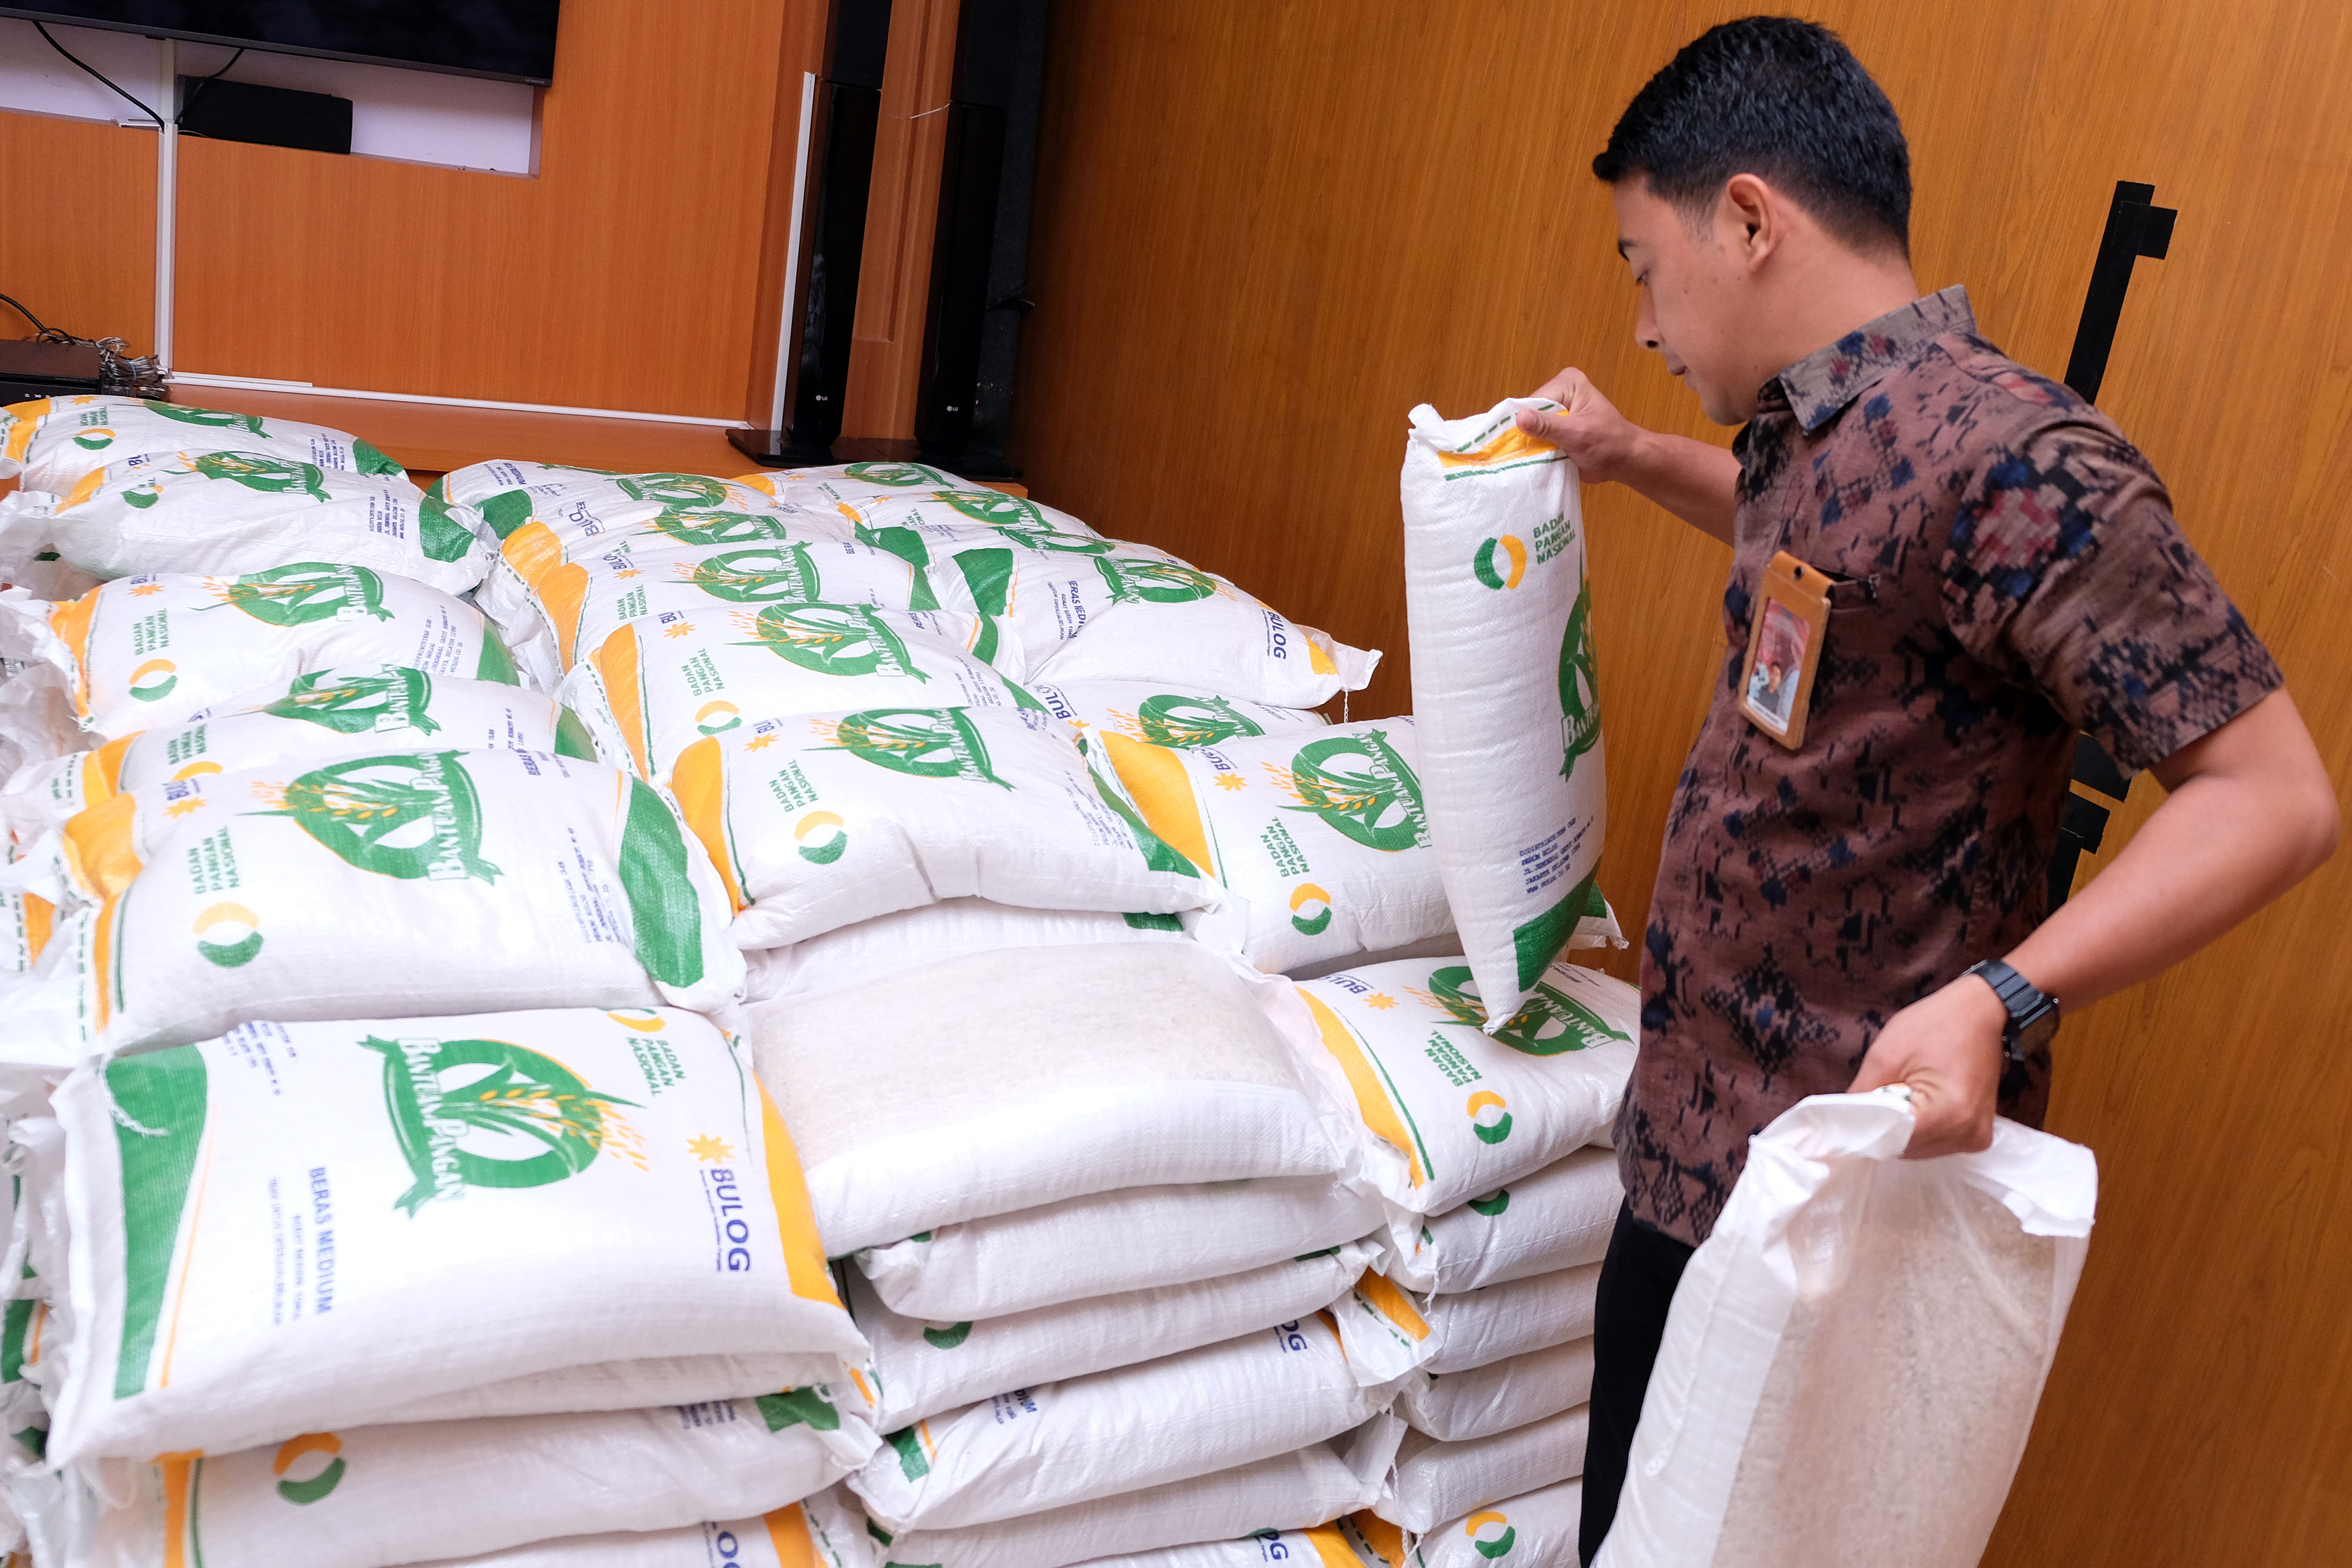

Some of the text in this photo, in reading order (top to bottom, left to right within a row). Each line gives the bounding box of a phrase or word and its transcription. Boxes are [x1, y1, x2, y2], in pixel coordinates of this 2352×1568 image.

[626, 592, 638, 617] PANGAN
[636, 584, 649, 615] NASIONAL
[784, 570, 808, 603] BANTUAN
[157, 608, 169, 648] NASIONAL
[617, 598, 627, 620] BADAN
[132, 622, 143, 655] BADAN
[143, 615, 156, 651] PANGAN
[867, 629, 906, 677] BANTUAN
[1267, 611, 1287, 660] BULOG
[681, 664, 702, 696] BADAN
[689, 657, 714, 693] PANGAN
[697, 647, 725, 690] NASIONAL
[768, 780, 795, 812] BADAN
[777, 769, 807, 808] PANGAN
[787, 759, 819, 802] NASIONAL
[1351, 732, 1432, 849] BANTUAN PANGAN
[216, 827, 240, 888] NASIONAL
[426, 790, 471, 881] BANTUAN
[1260, 834, 1290, 877] BADAN
[1266, 826, 1300, 875] PANGAN
[1271, 815, 1311, 873] NASIONAL
[187, 847, 207, 894] BADAN
[201, 836, 224, 891] PANGAN
[1546, 995, 1618, 1050] BANTUAN
[626, 1036, 662, 1096] NASIONAL
[642, 1039, 675, 1086] PANGAN
[657, 1040, 686, 1079] BADAN
[1423, 1048, 1464, 1087] BADAN
[1426, 1039, 1473, 1083] PANGAN
[1430, 1029, 1483, 1081] NASIONAL
[395, 1038, 470, 1202] BANTUAN PANGAN
[309, 1167, 334, 1314] BERAS MEDIUM
[710, 1169, 751, 1272] BULOG
